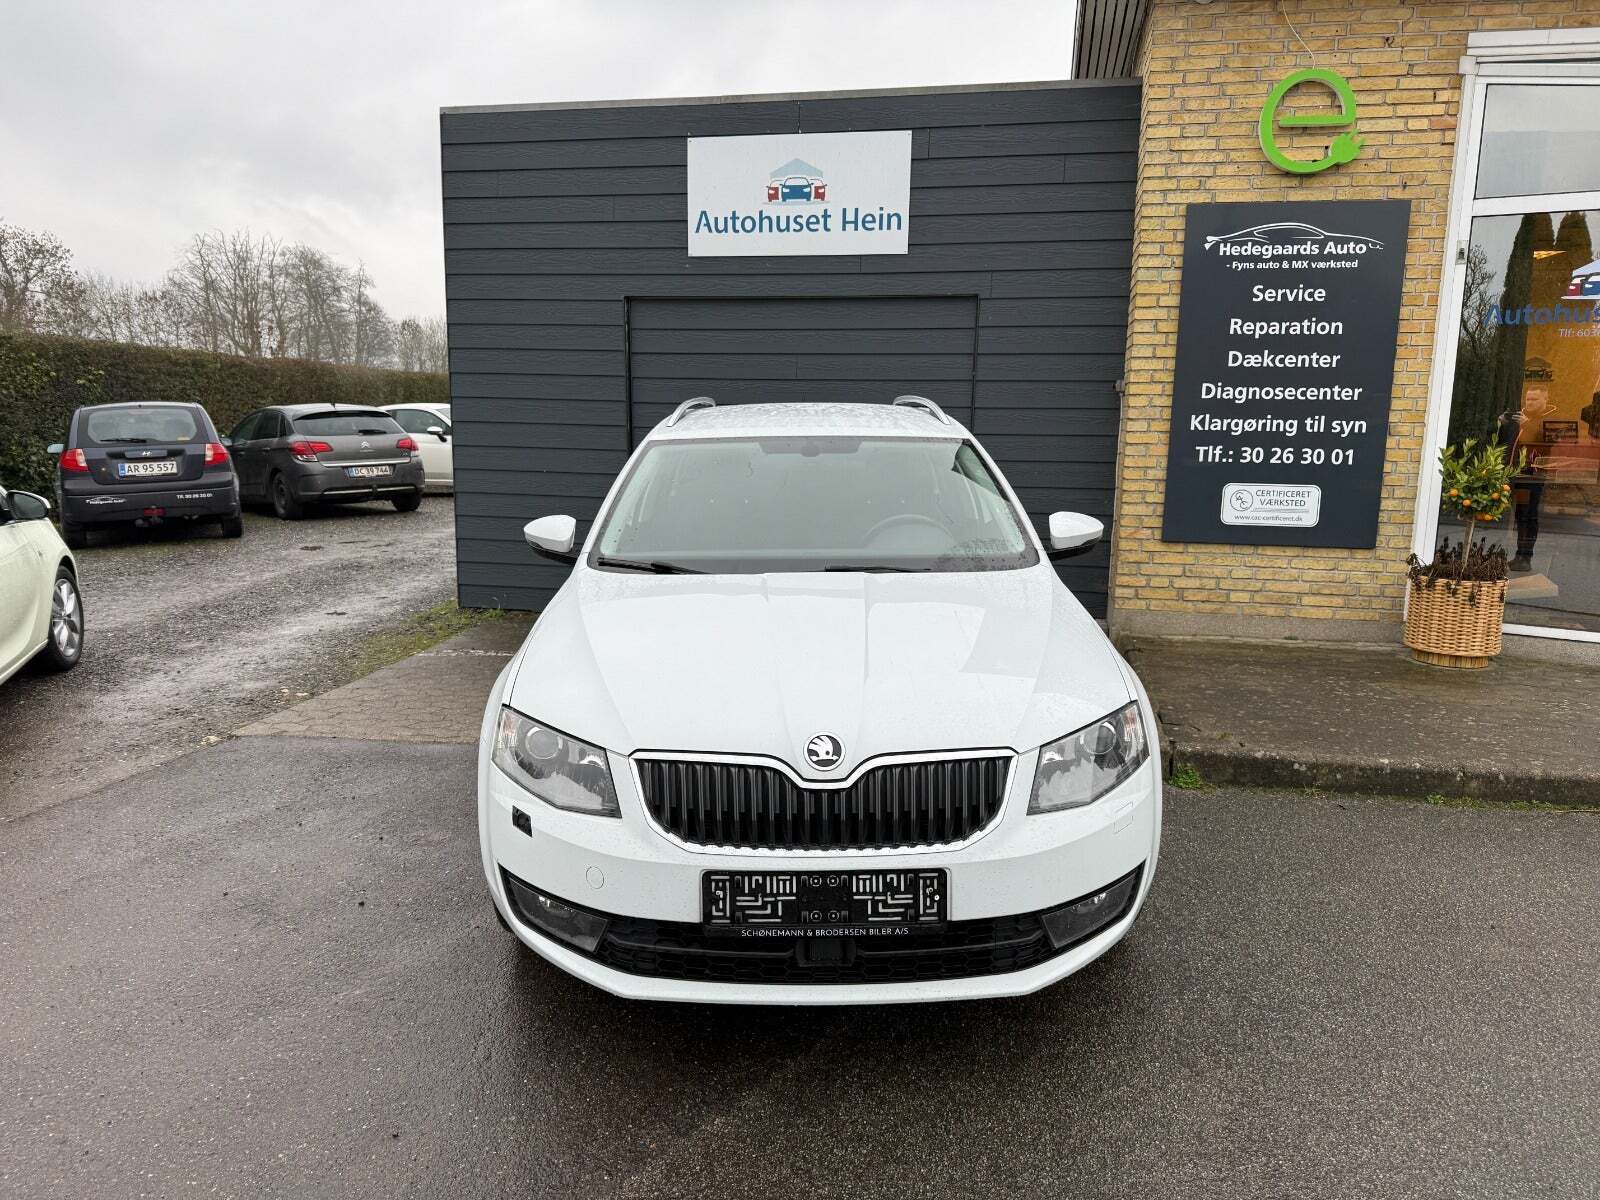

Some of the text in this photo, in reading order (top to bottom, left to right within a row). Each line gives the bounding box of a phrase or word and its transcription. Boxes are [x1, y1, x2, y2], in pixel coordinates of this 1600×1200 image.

[695, 206, 902, 234] Autohuset Hein
[1219, 241, 1367, 259] Hedegaards Auto
[1232, 260, 1255, 271] Fyns
[1257, 261, 1280, 269] auto
[1282, 260, 1290, 269] &
[1291, 260, 1309, 269] MX
[1311, 259, 1359, 269] værksted
[1252, 284, 1327, 302] Service
[1229, 317, 1343, 339] Reparation
[1227, 350, 1341, 368] Dækcenter
[1201, 382, 1363, 404] Diagnosecenter
[1190, 414, 1367, 438] Klargøring til syn
[1195, 445, 1354, 466] Tlf.: 30 26 30 01
[127, 463, 175, 474] AR 95 557
[1255, 489, 1312, 499] CERTIFICERET
[1259, 498, 1306, 507] VÆRKSTED
[741, 927, 909, 937] SCHØNEMANN & BRODERSEN BILER A/S
